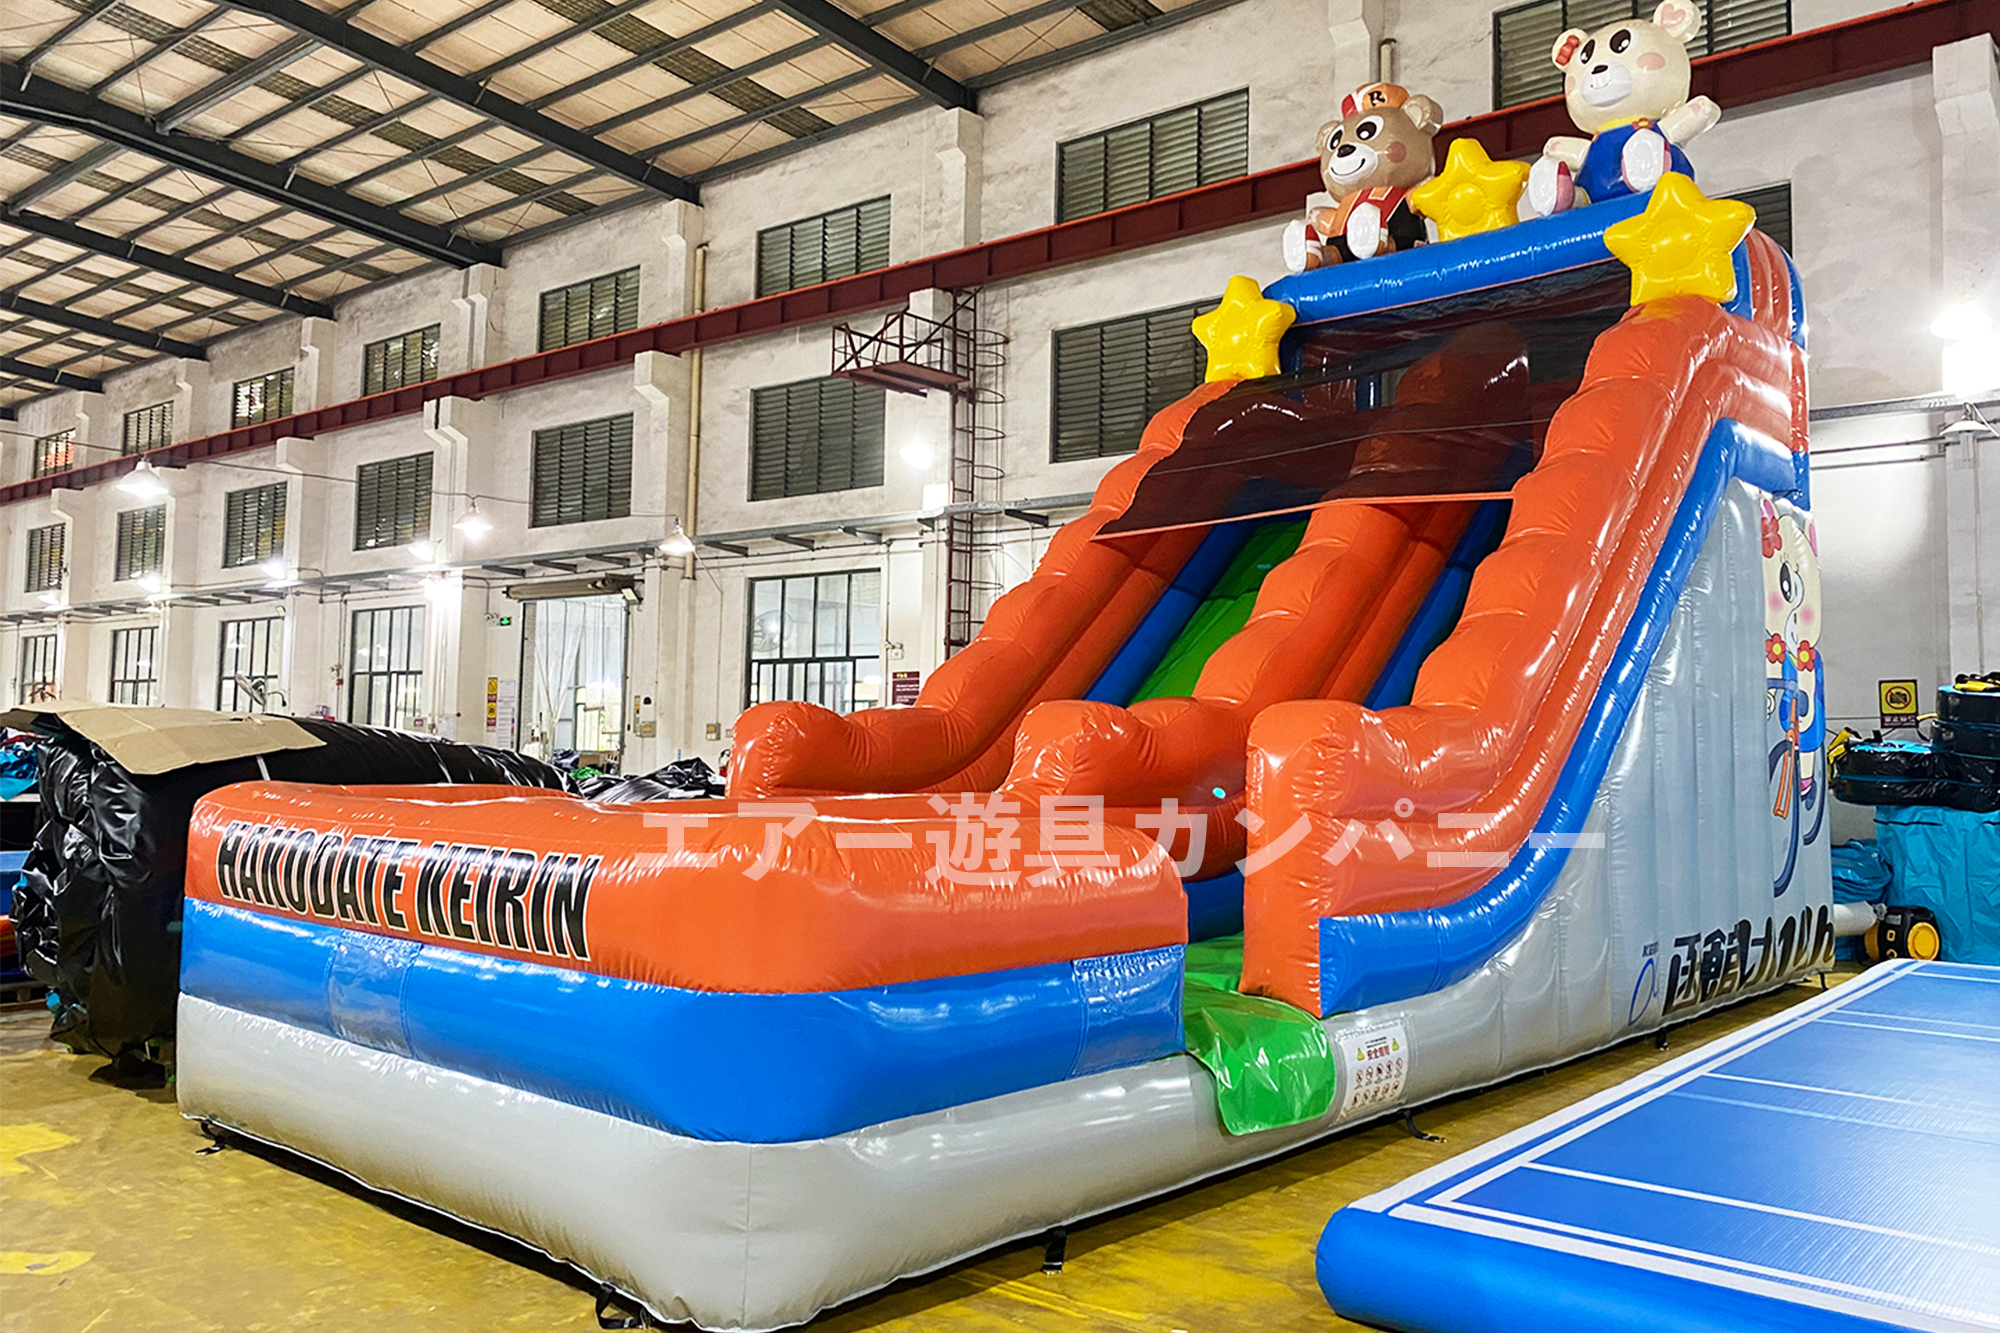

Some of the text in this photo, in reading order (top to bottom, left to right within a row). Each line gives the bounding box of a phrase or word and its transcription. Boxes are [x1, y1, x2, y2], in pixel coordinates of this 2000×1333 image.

[1368, 91, 1386, 106] R
[216, 820, 604, 962] HAKODATE KEIRIN
